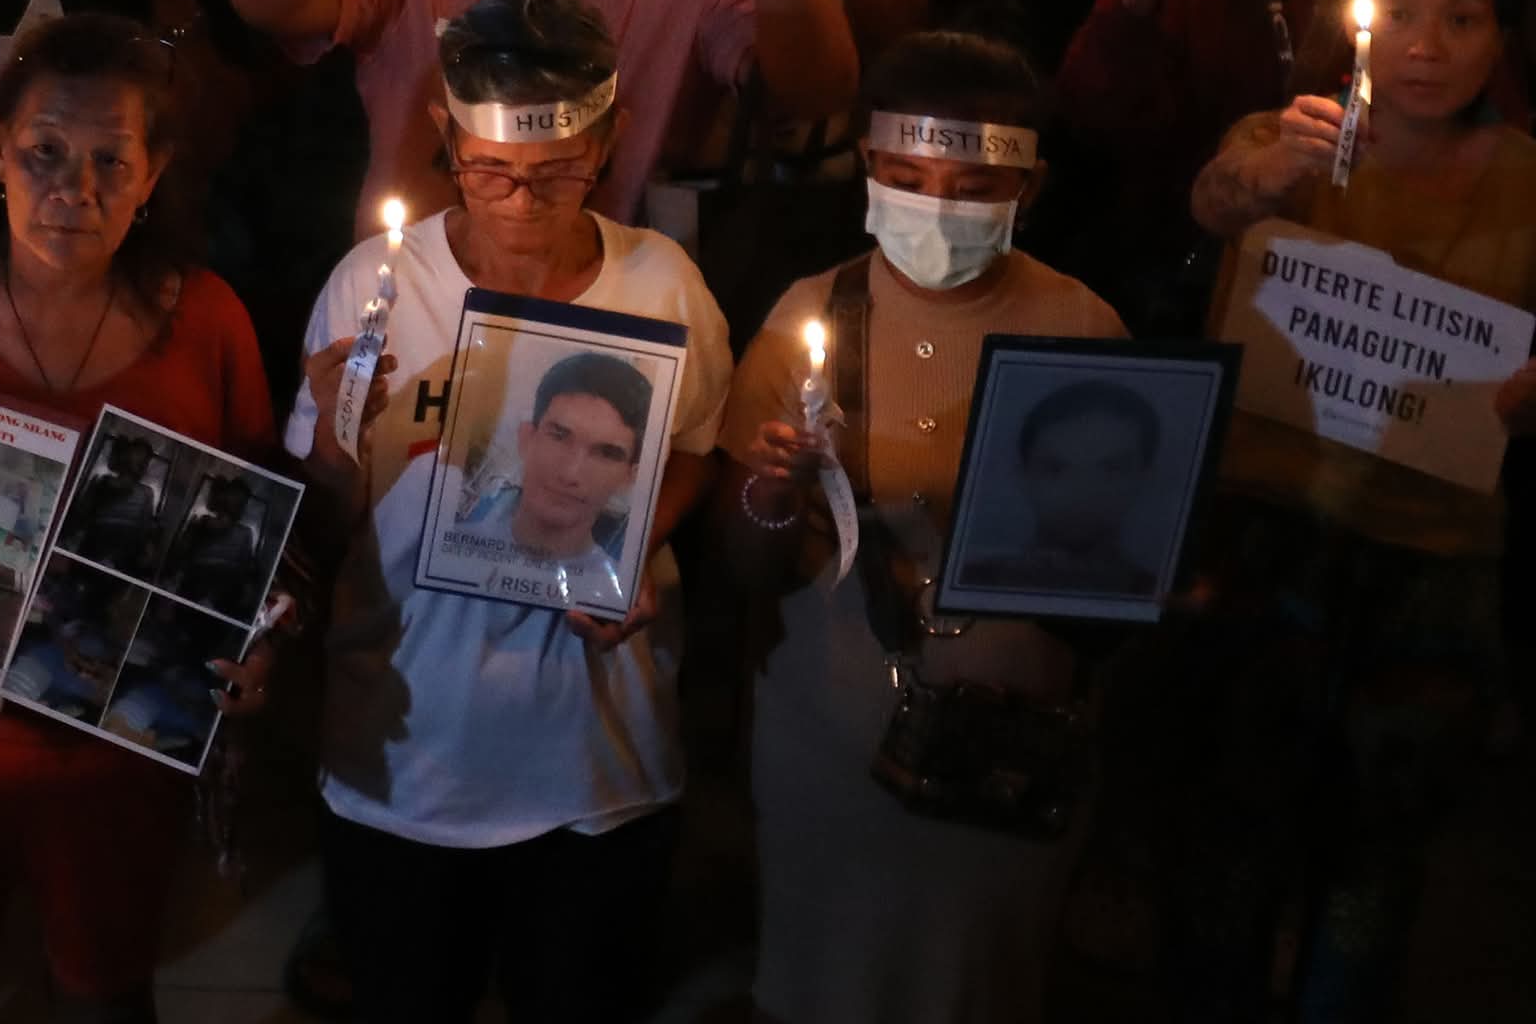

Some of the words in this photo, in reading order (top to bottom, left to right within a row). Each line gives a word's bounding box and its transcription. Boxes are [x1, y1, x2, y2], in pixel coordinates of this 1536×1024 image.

[900, 123, 1021, 157] HUSTISYA
[1261, 250, 1385, 312] DUTERTE
[1293, 359, 1427, 424] IKULONG!
[23, 418, 66, 442] SILANG
[501, 576, 543, 596] RISE
